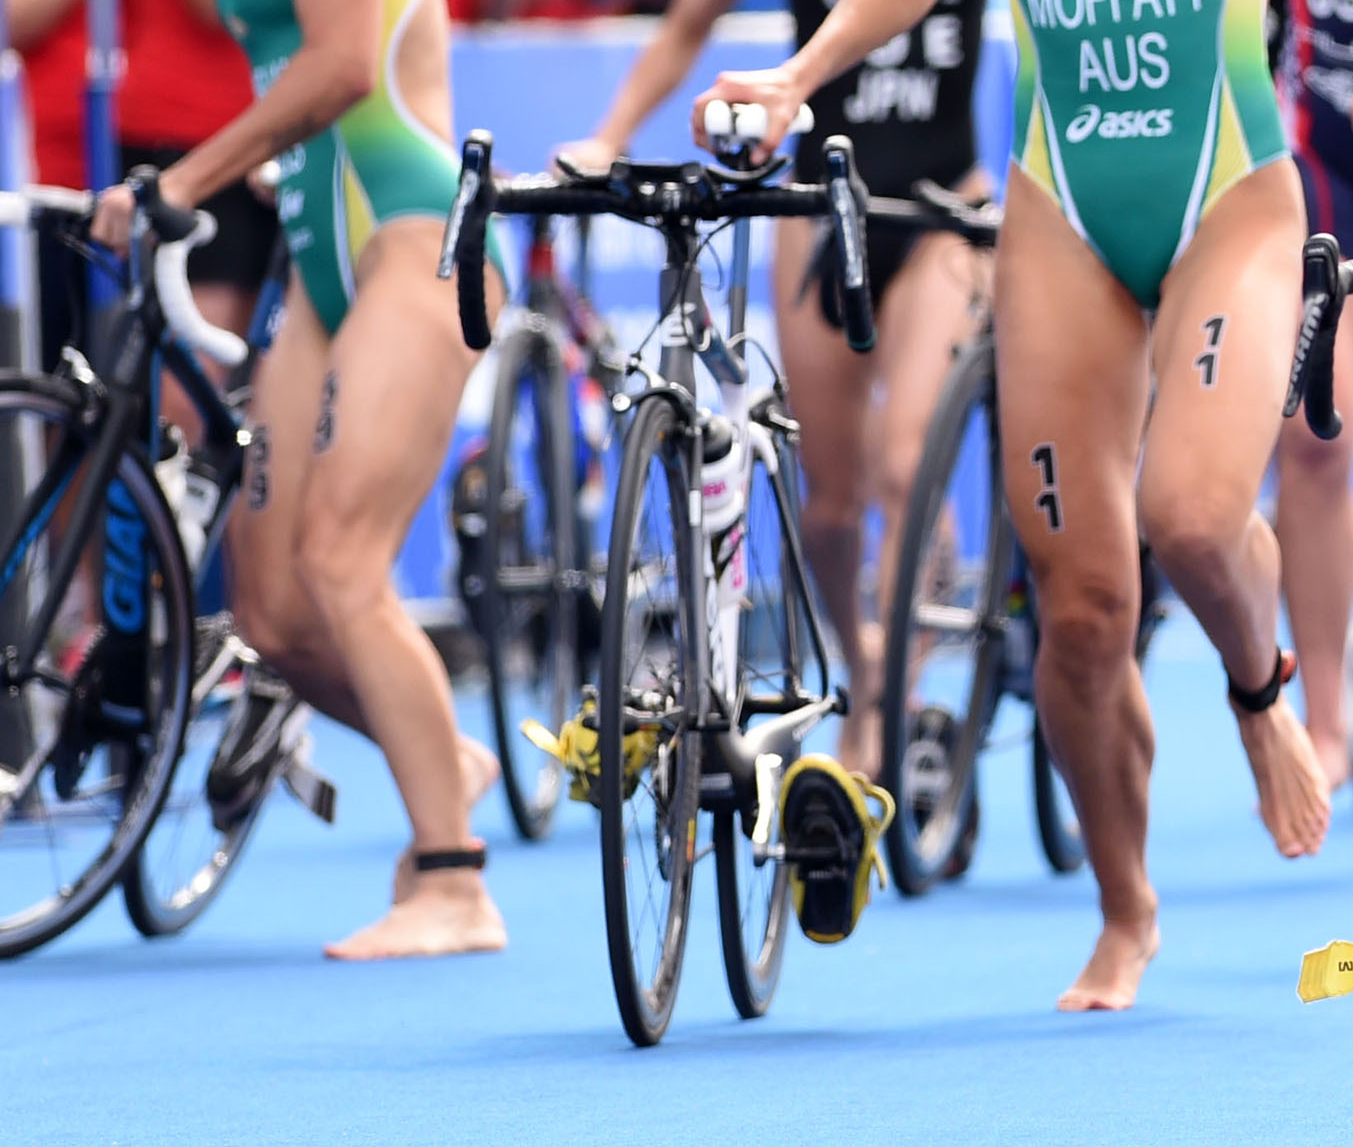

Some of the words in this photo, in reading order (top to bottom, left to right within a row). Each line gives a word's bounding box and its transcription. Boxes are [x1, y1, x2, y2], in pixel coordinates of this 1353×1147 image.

[1079, 32, 1170, 93] AUS
[1195, 315, 1225, 388] 11
[1032, 442, 1062, 533] 11
